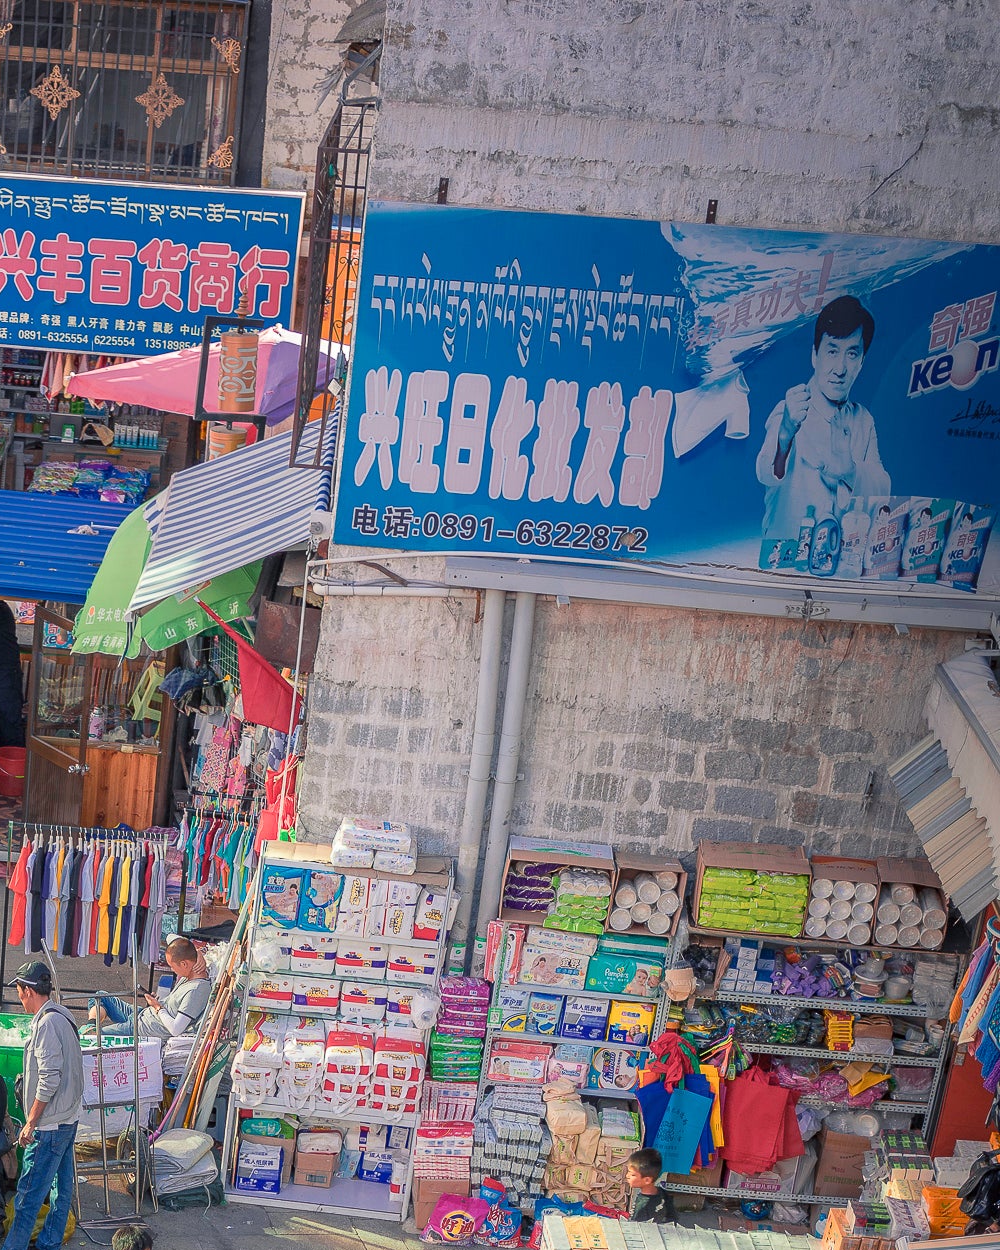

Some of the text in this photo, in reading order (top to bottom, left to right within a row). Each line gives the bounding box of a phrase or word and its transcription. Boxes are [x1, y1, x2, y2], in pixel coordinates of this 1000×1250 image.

[40, 314, 61, 327] 奇强
[67, 316, 110, 330] 黑人牙膏
[115, 319, 147, 332] 隆力奇
[929, 291, 997, 352] 奇强
[18, 330, 89, 344] 0891-6325554
[94, 335, 135, 347] 6225554
[354, 366, 673, 510] 兴旺日化批发部
[604, 967, 630, 981] Pampers
[571, 1003, 603, 1014] 成人纸尿裤
